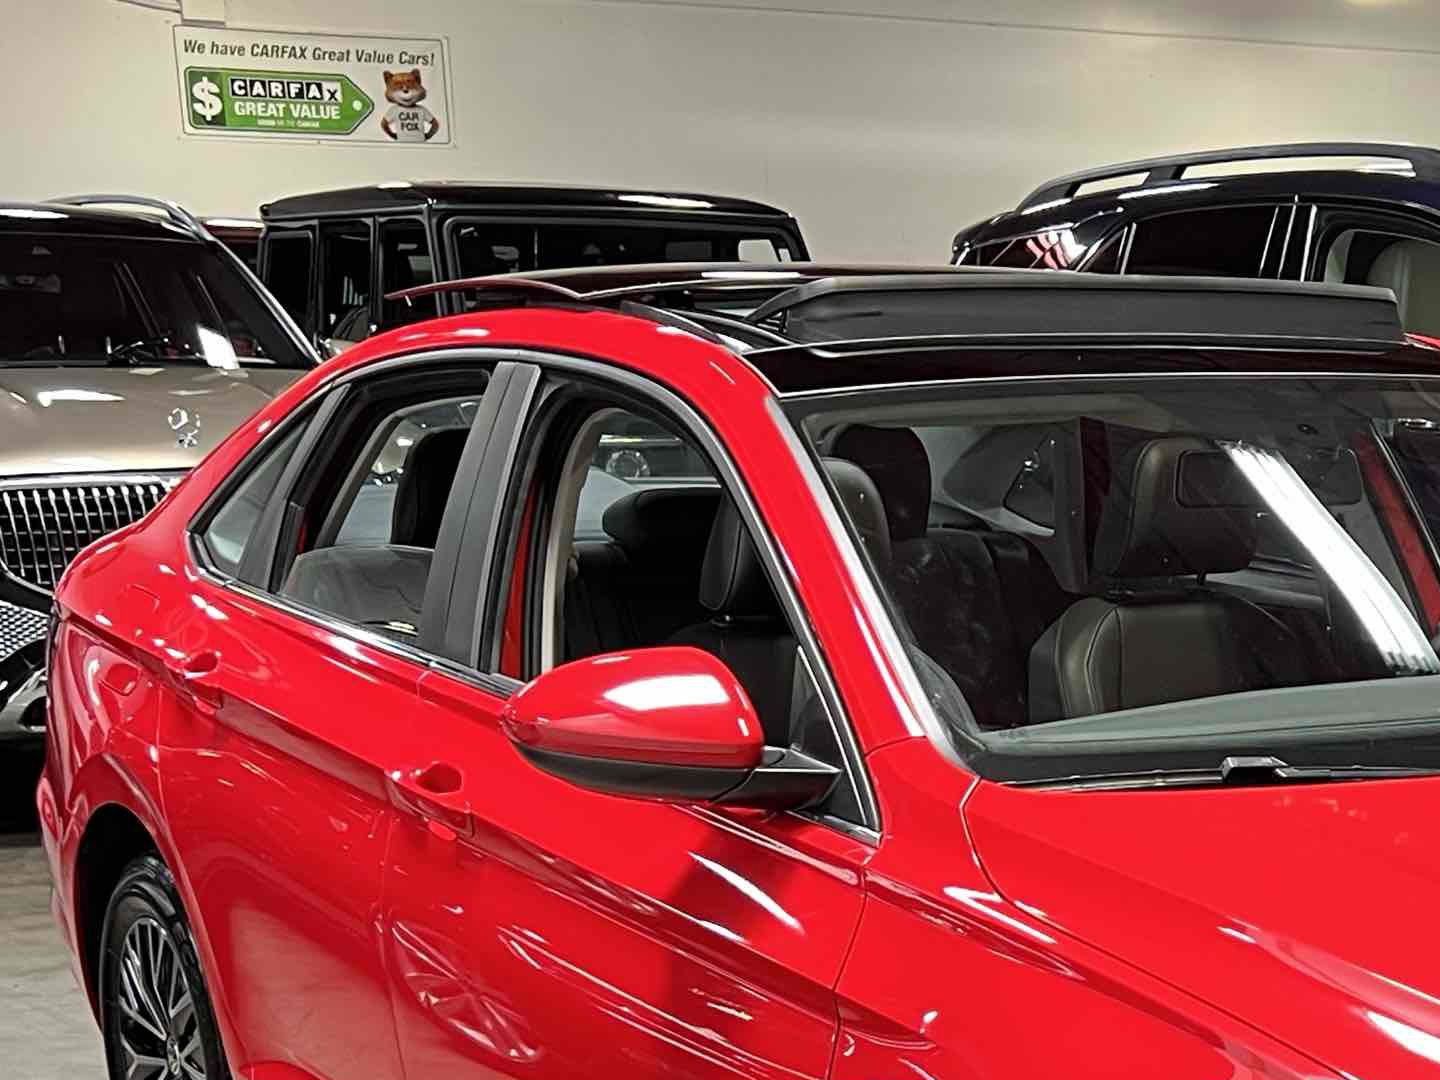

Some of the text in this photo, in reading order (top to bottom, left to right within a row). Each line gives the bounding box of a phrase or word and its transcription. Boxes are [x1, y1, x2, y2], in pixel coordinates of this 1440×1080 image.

[183, 39, 435, 67] We have CARFAX Great Value Cars!
[231, 78, 341, 103] CARFAX
[234, 101, 341, 120] GREAT VALUE
